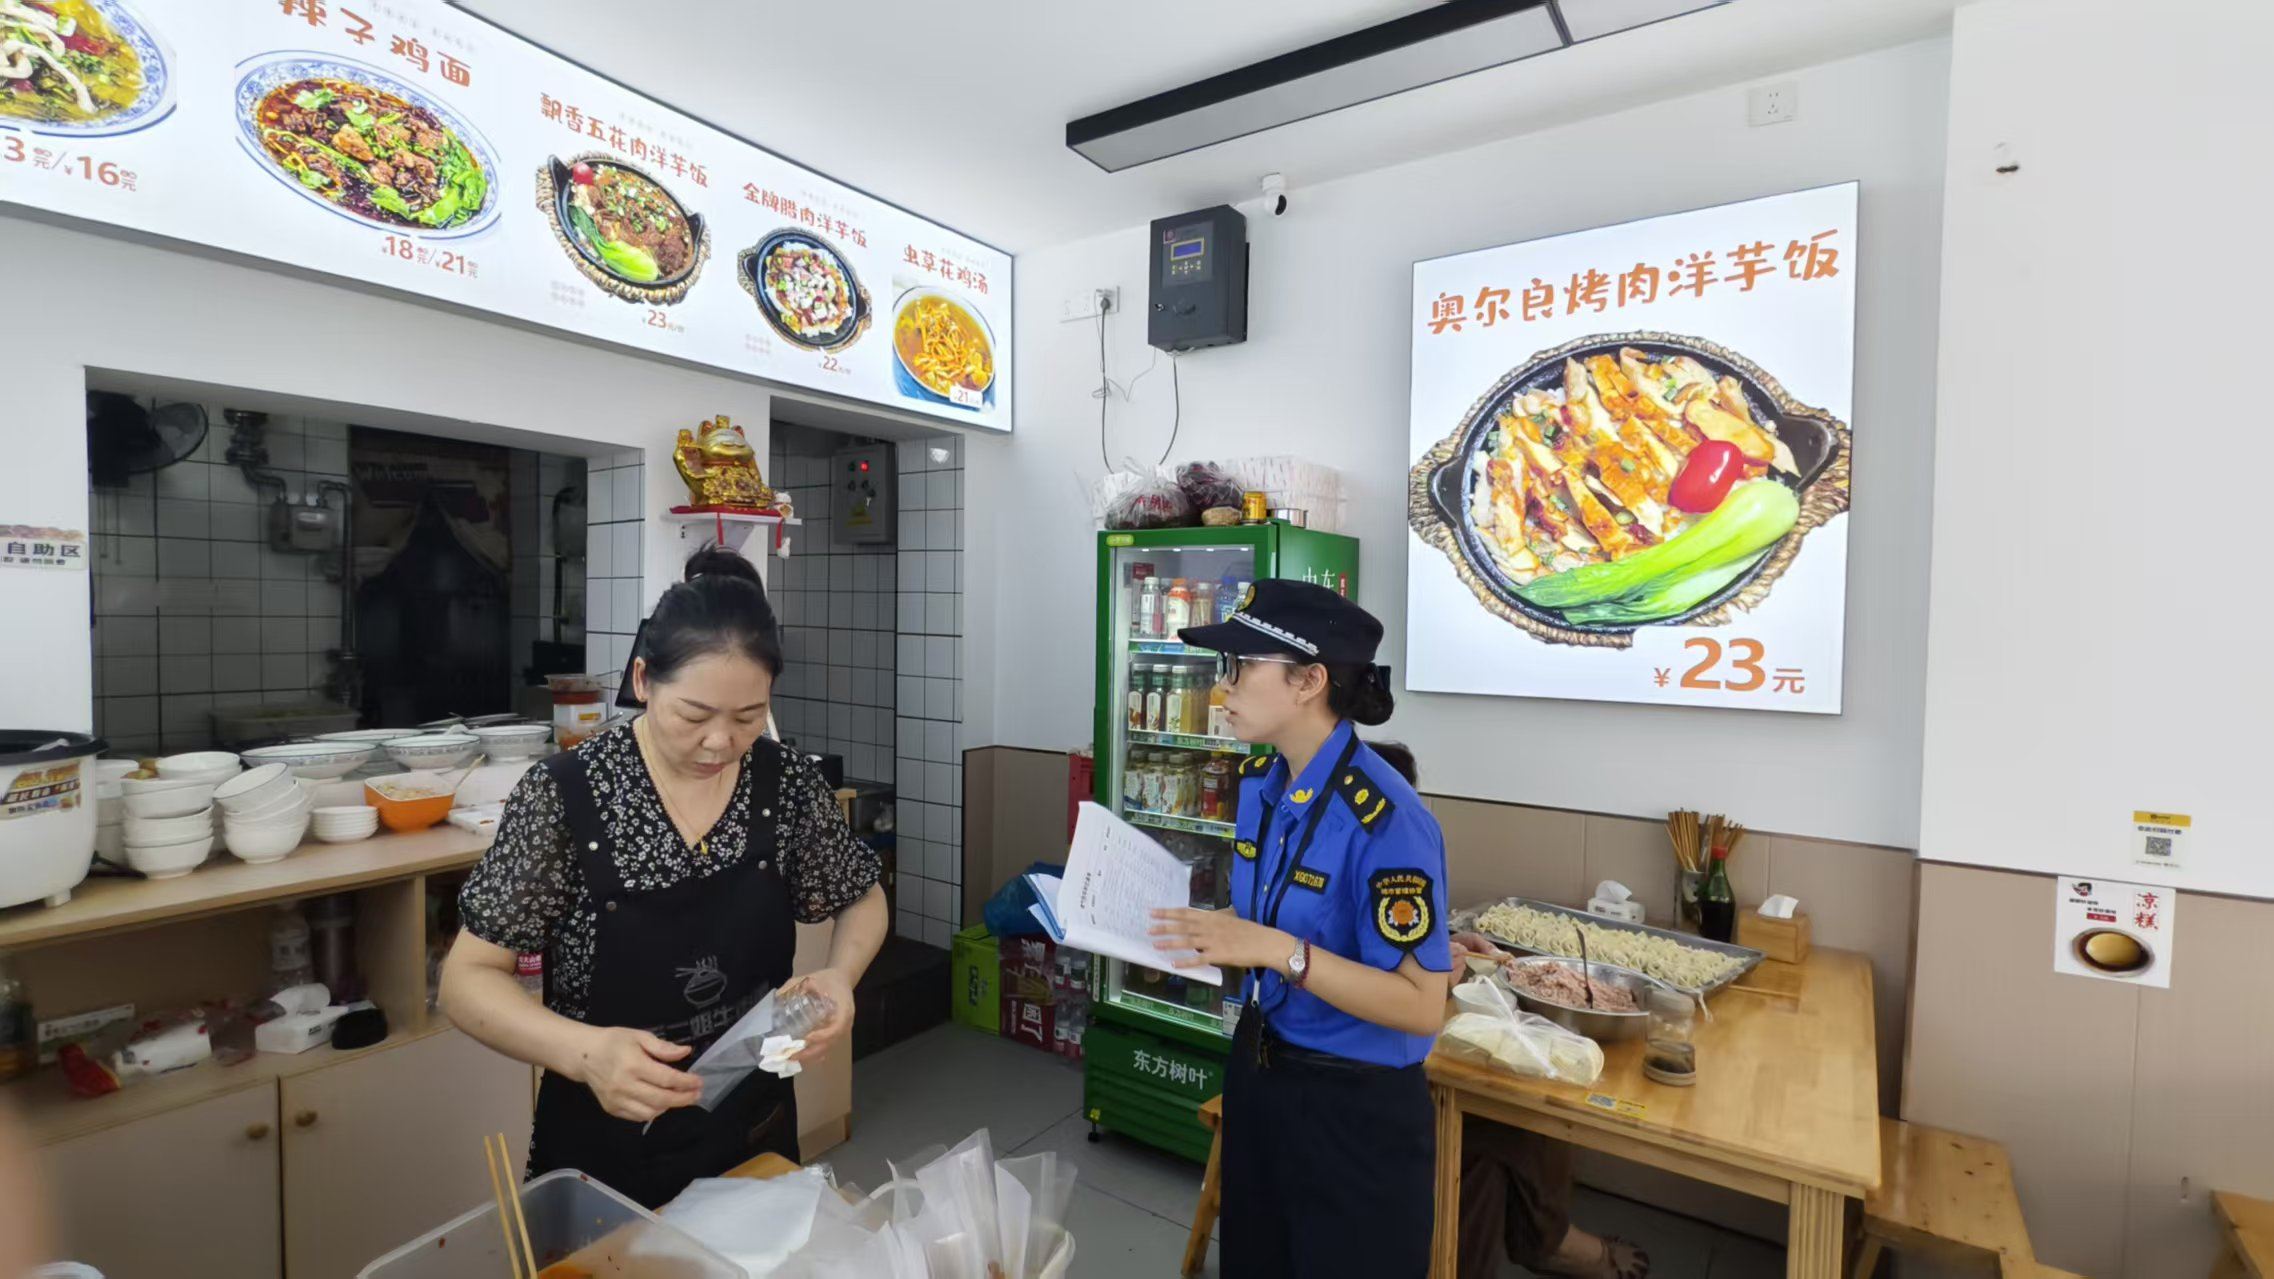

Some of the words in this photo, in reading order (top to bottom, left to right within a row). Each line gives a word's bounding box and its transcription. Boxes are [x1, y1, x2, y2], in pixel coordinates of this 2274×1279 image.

[540, 91, 709, 188] 飘香五花肉洋芋饭
[743, 182, 867, 248] 金牌腊肉洋芋饭
[902, 243, 989, 295] 虫草花鸡汤
[1427, 229, 1841, 335] 奥尔良烤肉洋芋饭
[7, 541, 82, 558] 自助区
[1133, 1049, 1208, 1091] 东方树叶
